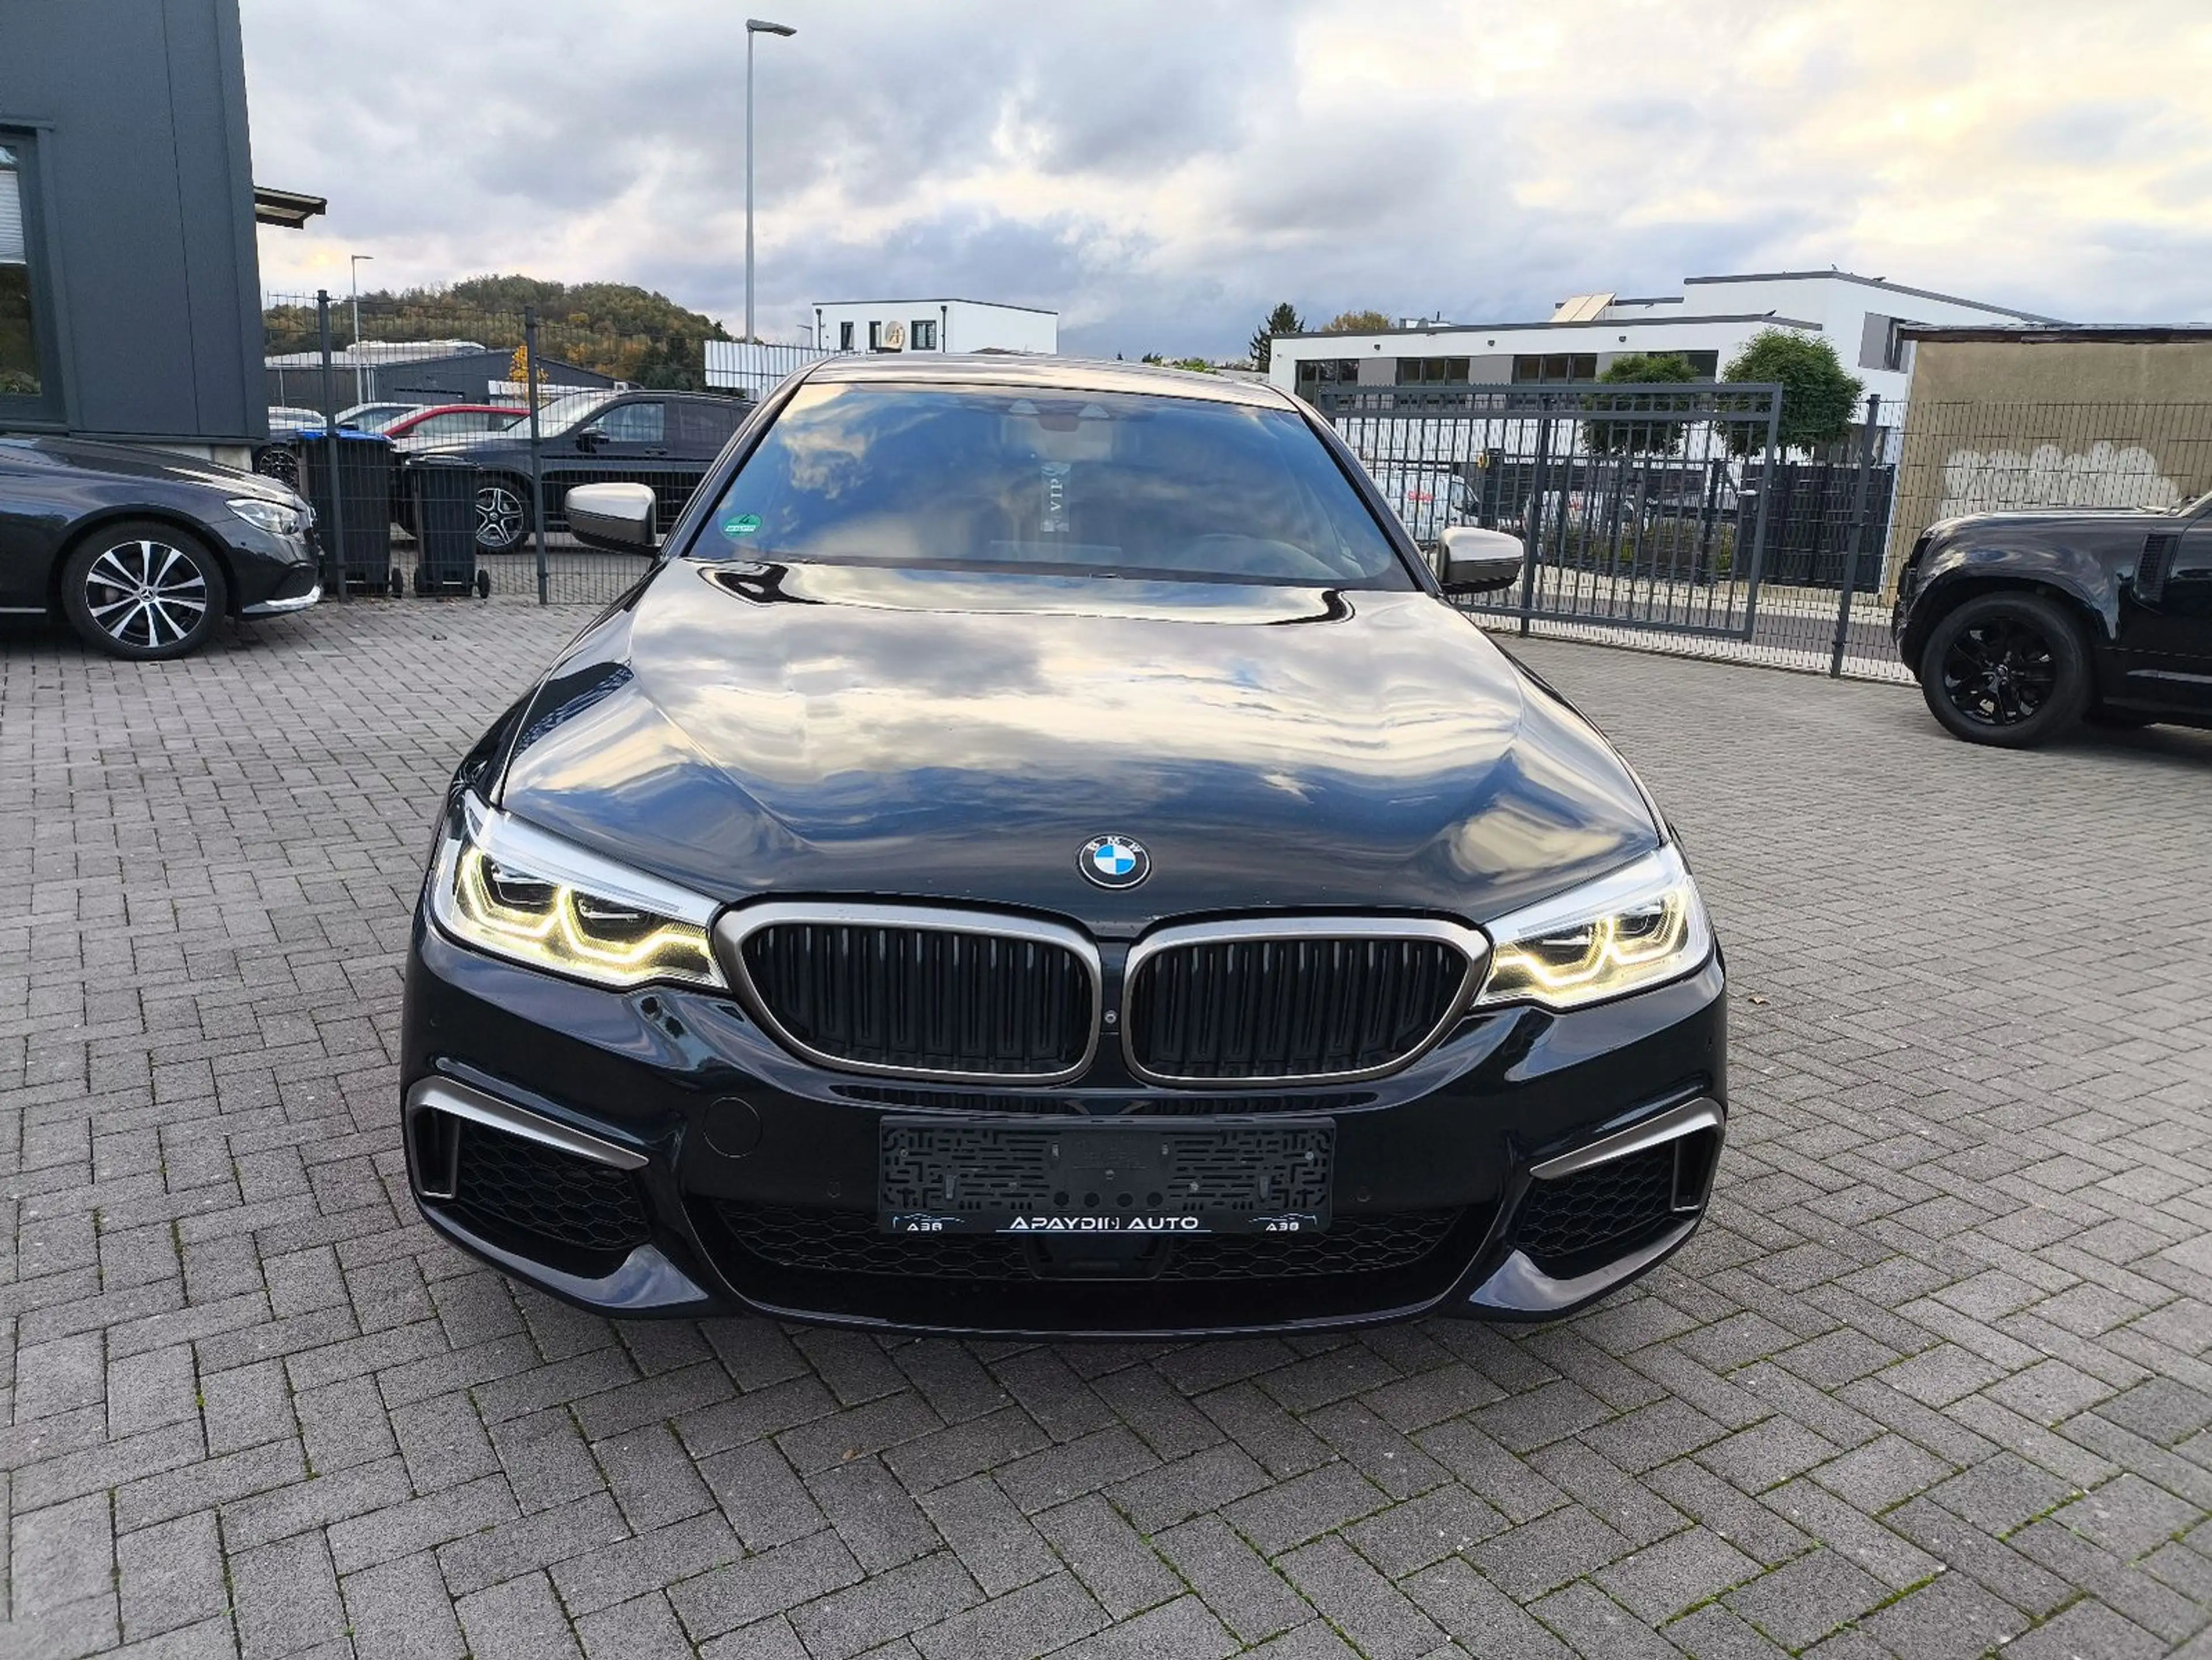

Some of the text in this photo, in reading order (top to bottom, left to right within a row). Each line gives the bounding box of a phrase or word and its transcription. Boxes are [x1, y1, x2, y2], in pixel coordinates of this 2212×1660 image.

[1050, 478, 1063, 511] VIP
[1087, 836, 1141, 852] BMW
[1126, 1216, 1199, 1229] AUTO
